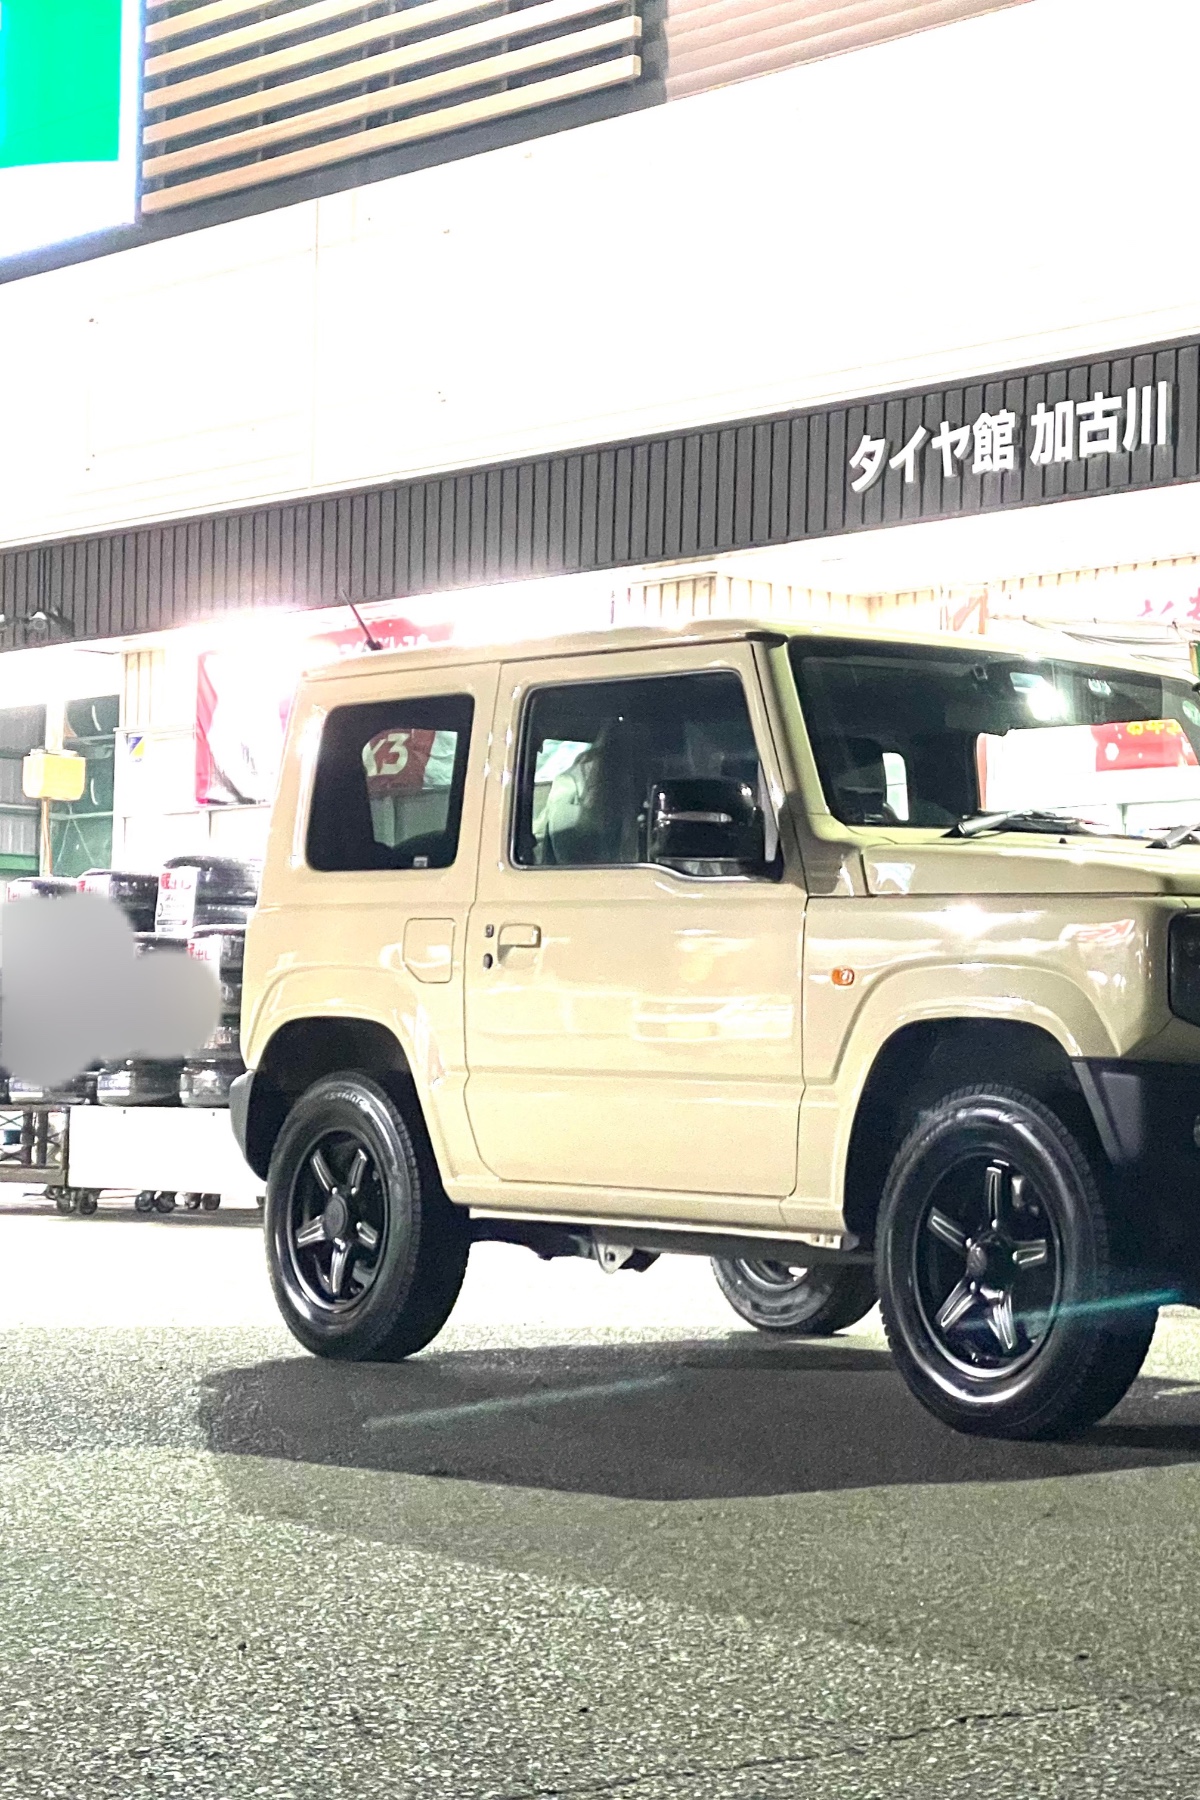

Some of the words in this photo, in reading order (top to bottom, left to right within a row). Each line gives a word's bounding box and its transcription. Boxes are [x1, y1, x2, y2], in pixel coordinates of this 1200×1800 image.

[850, 410, 1016, 493] タイヤ館
[1030, 381, 1172, 466] 加古川
